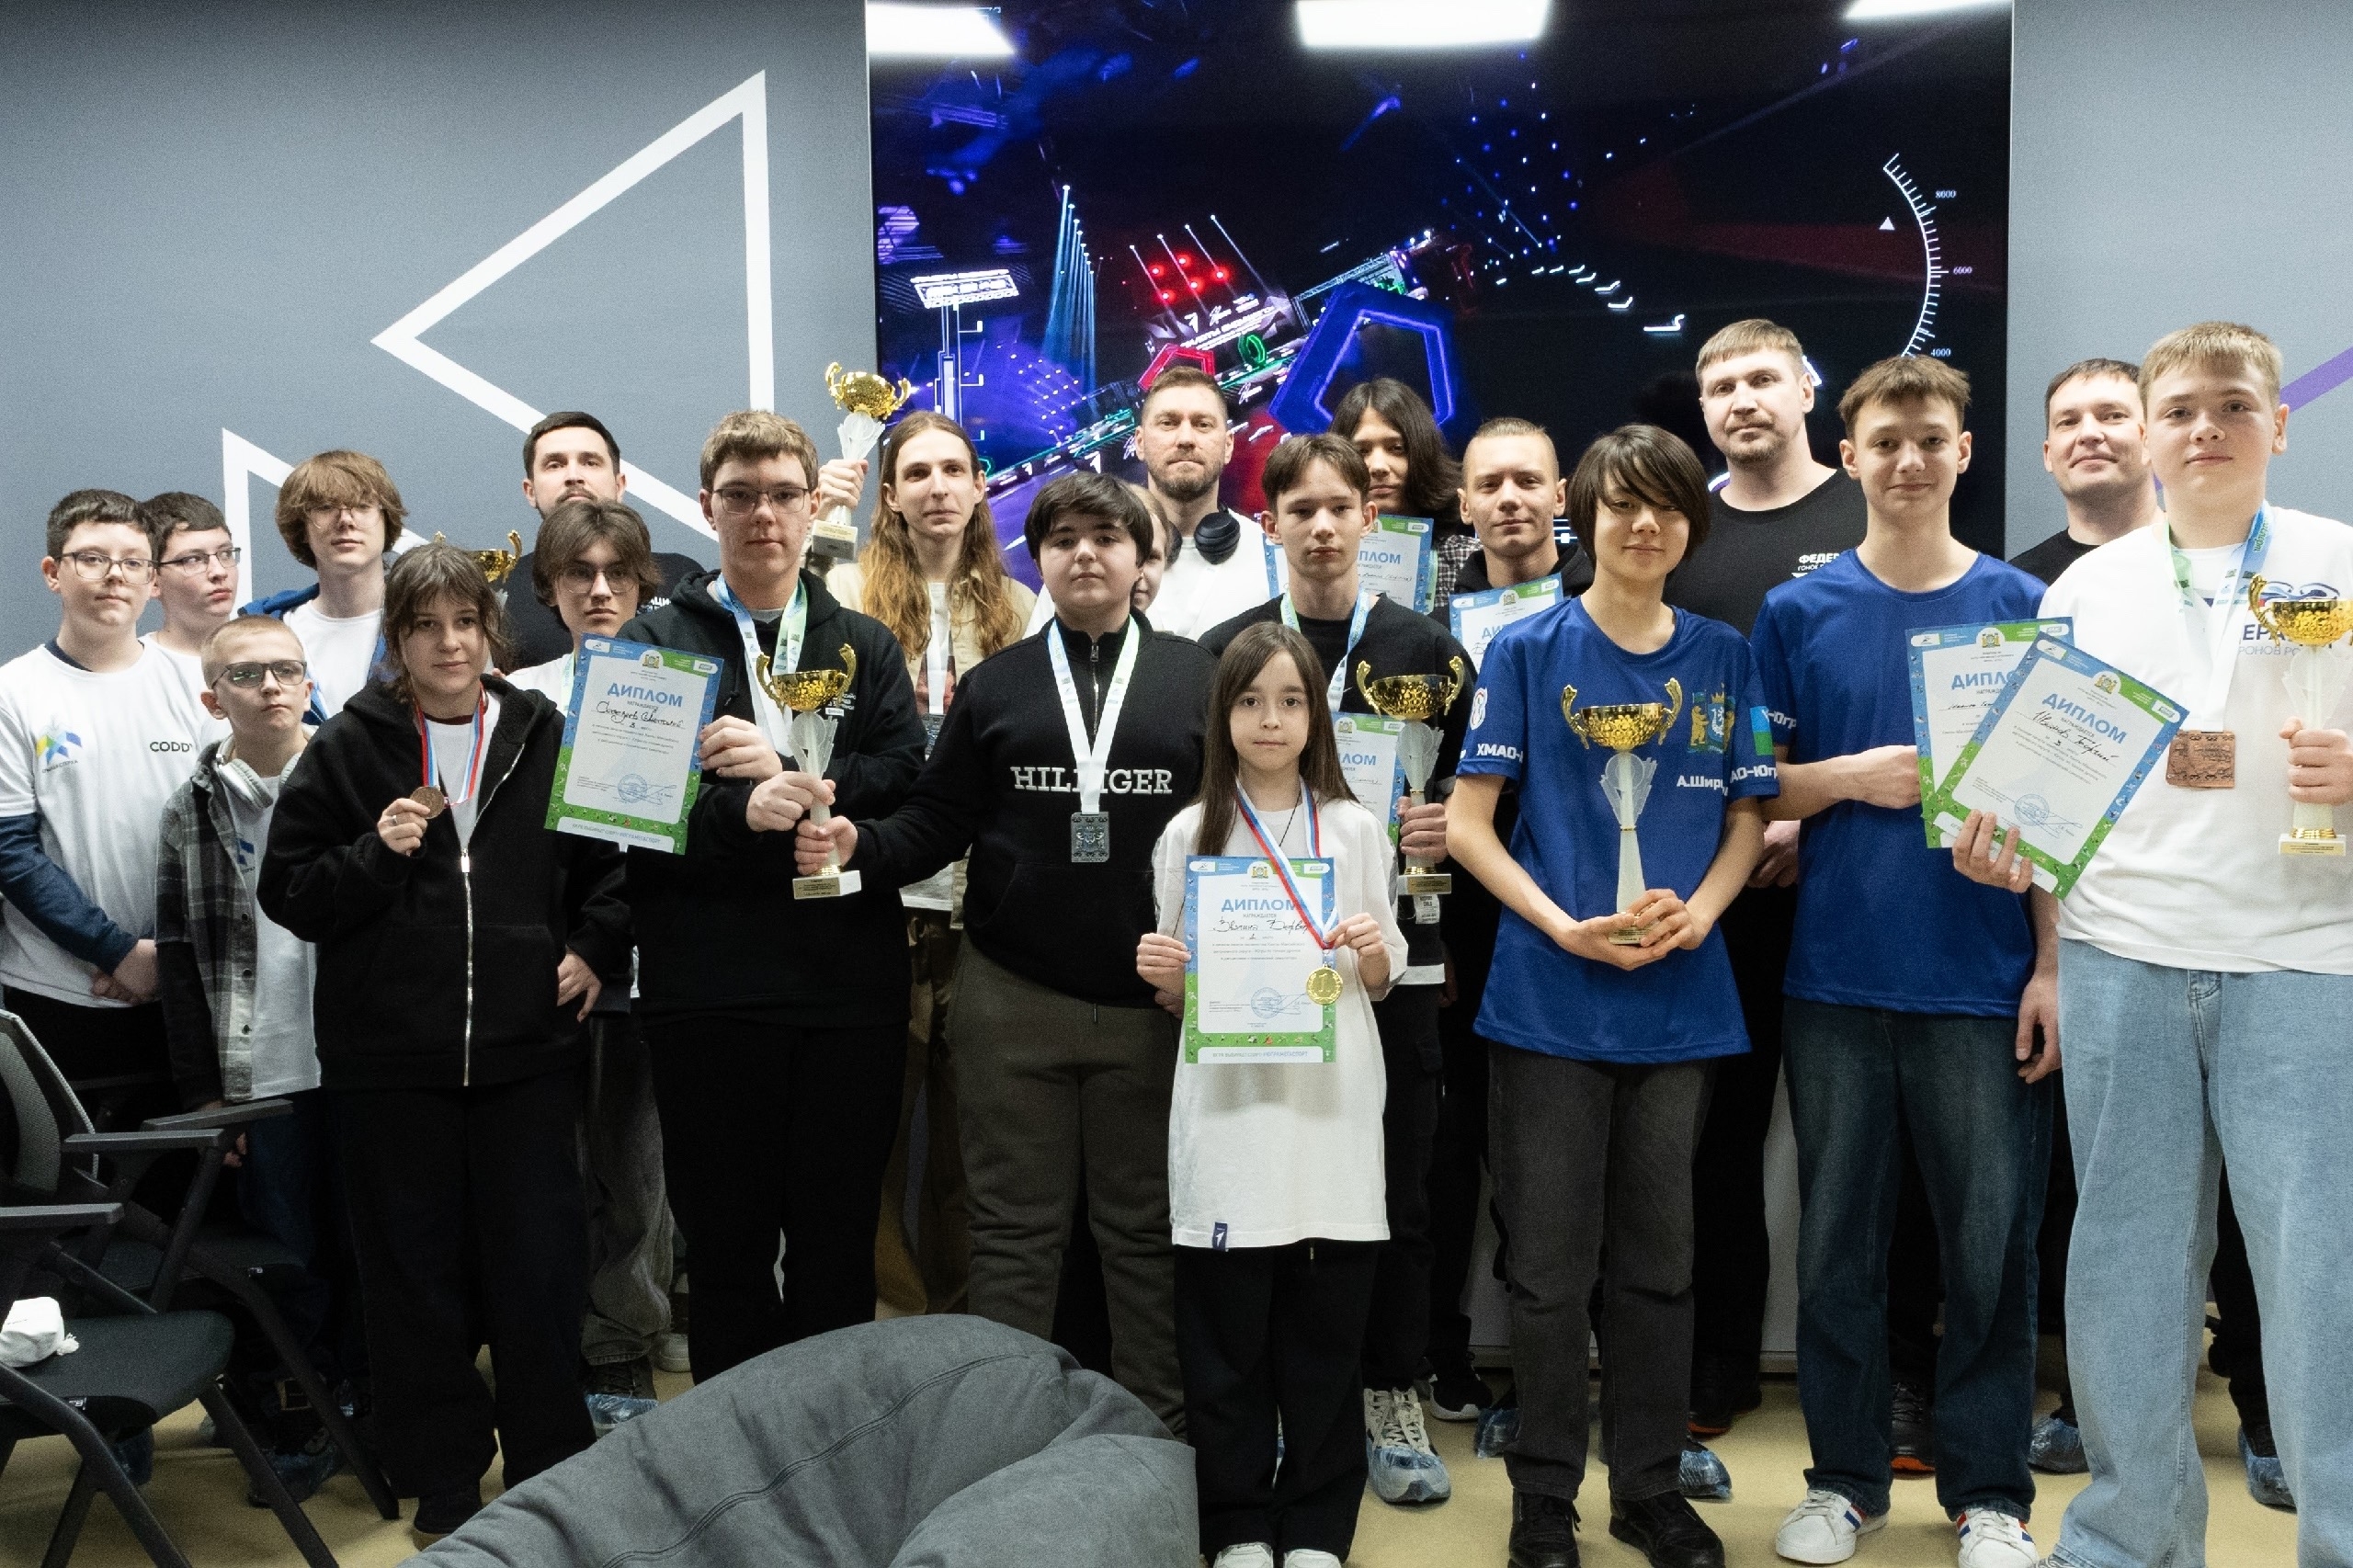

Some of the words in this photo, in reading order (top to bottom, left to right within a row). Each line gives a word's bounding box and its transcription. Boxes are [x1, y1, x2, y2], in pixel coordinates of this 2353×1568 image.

[1935, 189, 1957, 199] 8000
[1953, 266, 1973, 275] 6000
[1930, 347, 1951, 357] 4000
[1358, 551, 1402, 564] ПЛОМ
[2242, 624, 2286, 641] ЕРА
[2238, 645, 2281, 655] РОНОВ
[1951, 669, 2016, 690] ДИПЛ
[607, 682, 684, 708] ДИПЛОМ
[1768, 710, 1797, 729] -Югр
[2042, 693, 2128, 744] ДИПЛОМ
[150, 740, 193, 753] CODD
[1476, 743, 1524, 764] ХМАО-
[1341, 753, 1377, 766] ЛОМ
[1730, 764, 1778, 784] АО-Юг
[1221, 899, 1295, 913] ДИПЛОМ
